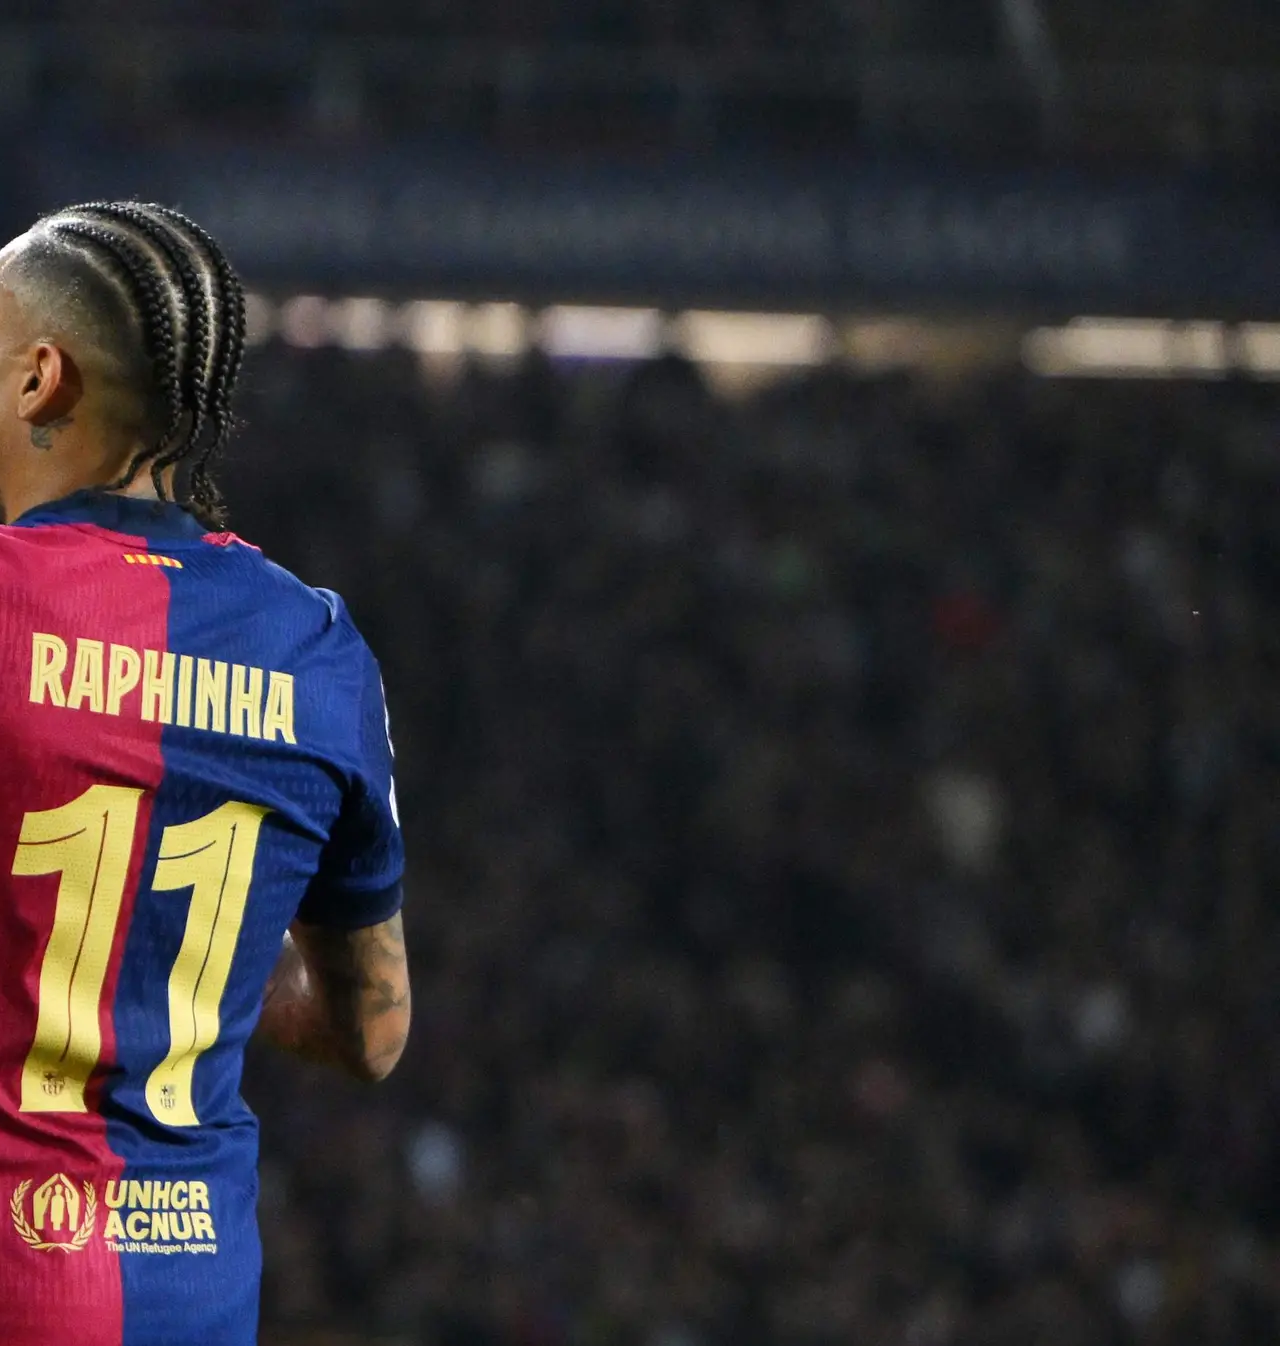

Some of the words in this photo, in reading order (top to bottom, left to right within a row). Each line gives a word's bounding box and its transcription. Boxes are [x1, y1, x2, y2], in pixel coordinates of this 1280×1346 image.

[30, 632, 297, 745] RAPHINHA
[11, 785, 273, 1127] 11
[104, 1180, 210, 1210] UNHCR
[103, 1210, 216, 1241] ACNUR
[105, 1241, 124, 1251] The
[125, 1242, 140, 1253] UN
[141, 1243, 182, 1255] Refugee
[184, 1242, 217, 1254] Agency
